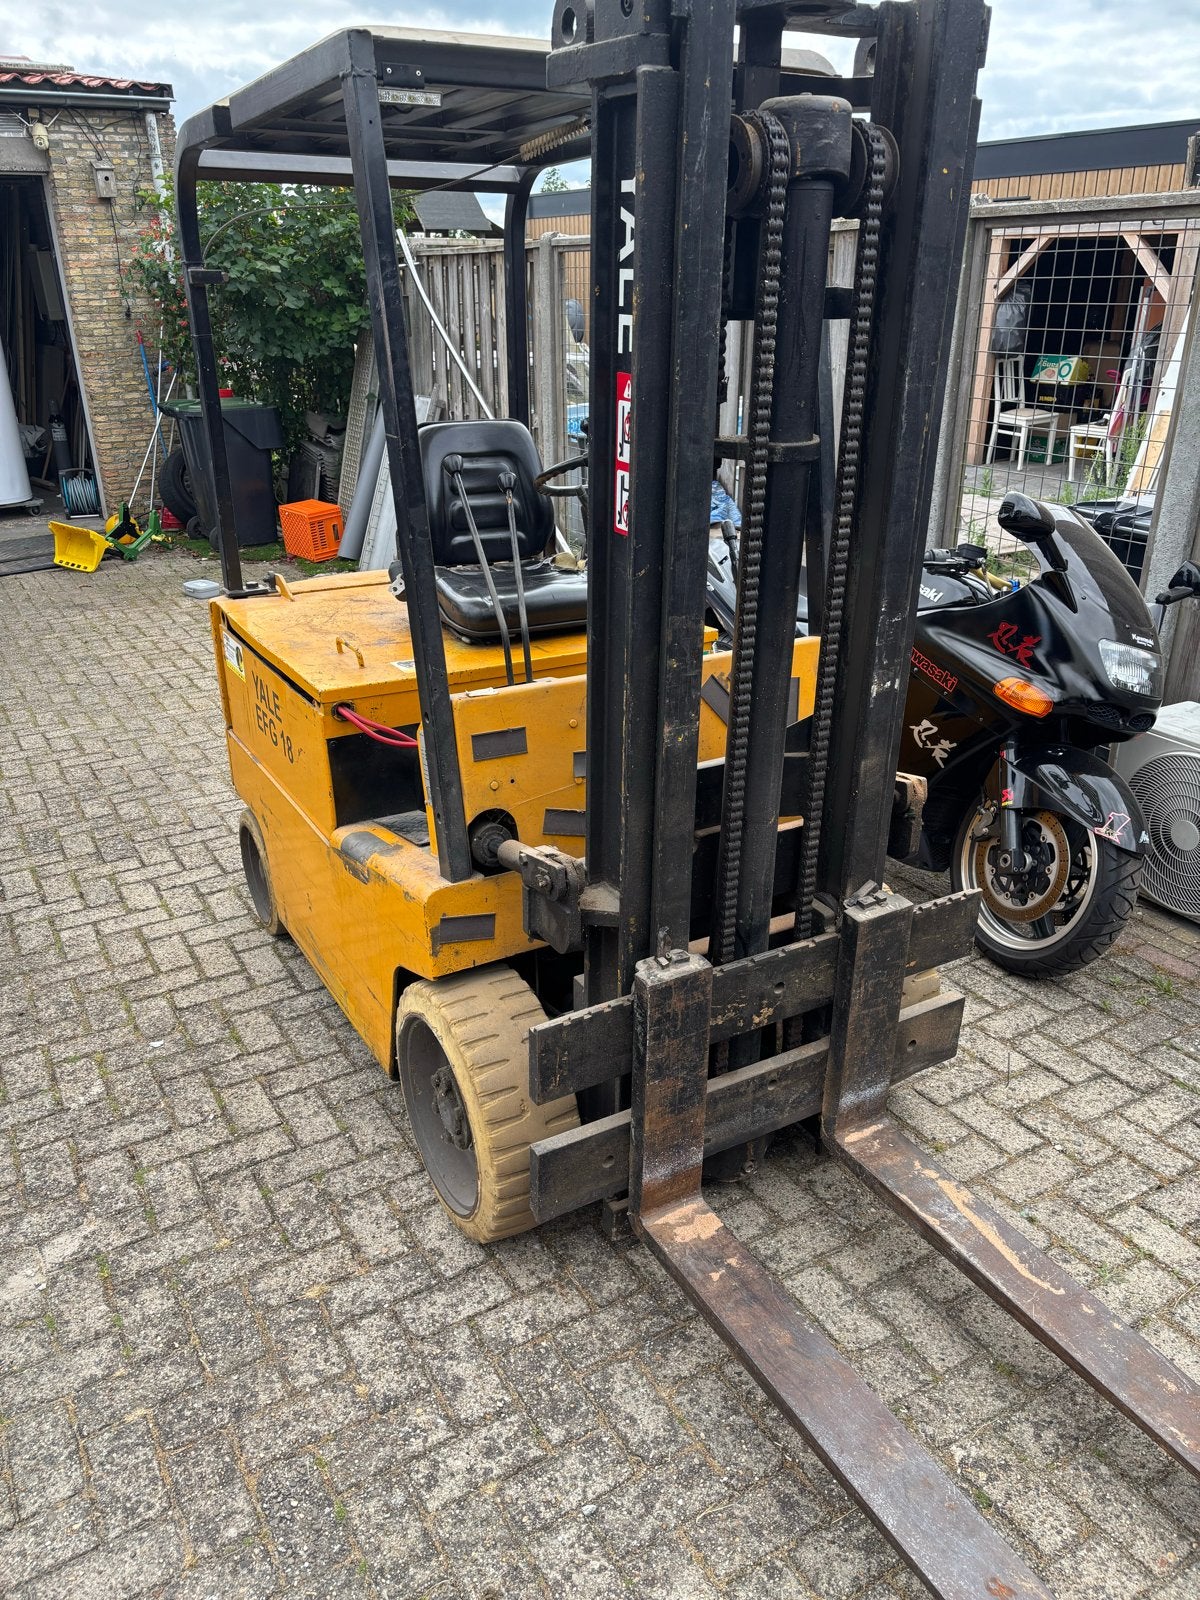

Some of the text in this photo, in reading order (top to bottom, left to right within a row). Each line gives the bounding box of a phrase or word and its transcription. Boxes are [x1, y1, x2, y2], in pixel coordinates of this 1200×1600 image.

[919, 583, 944, 603] saki
[911, 646, 959, 692] wasaki
[251, 670, 283, 724] YALE
[255, 703, 294, 764] EFG 18
